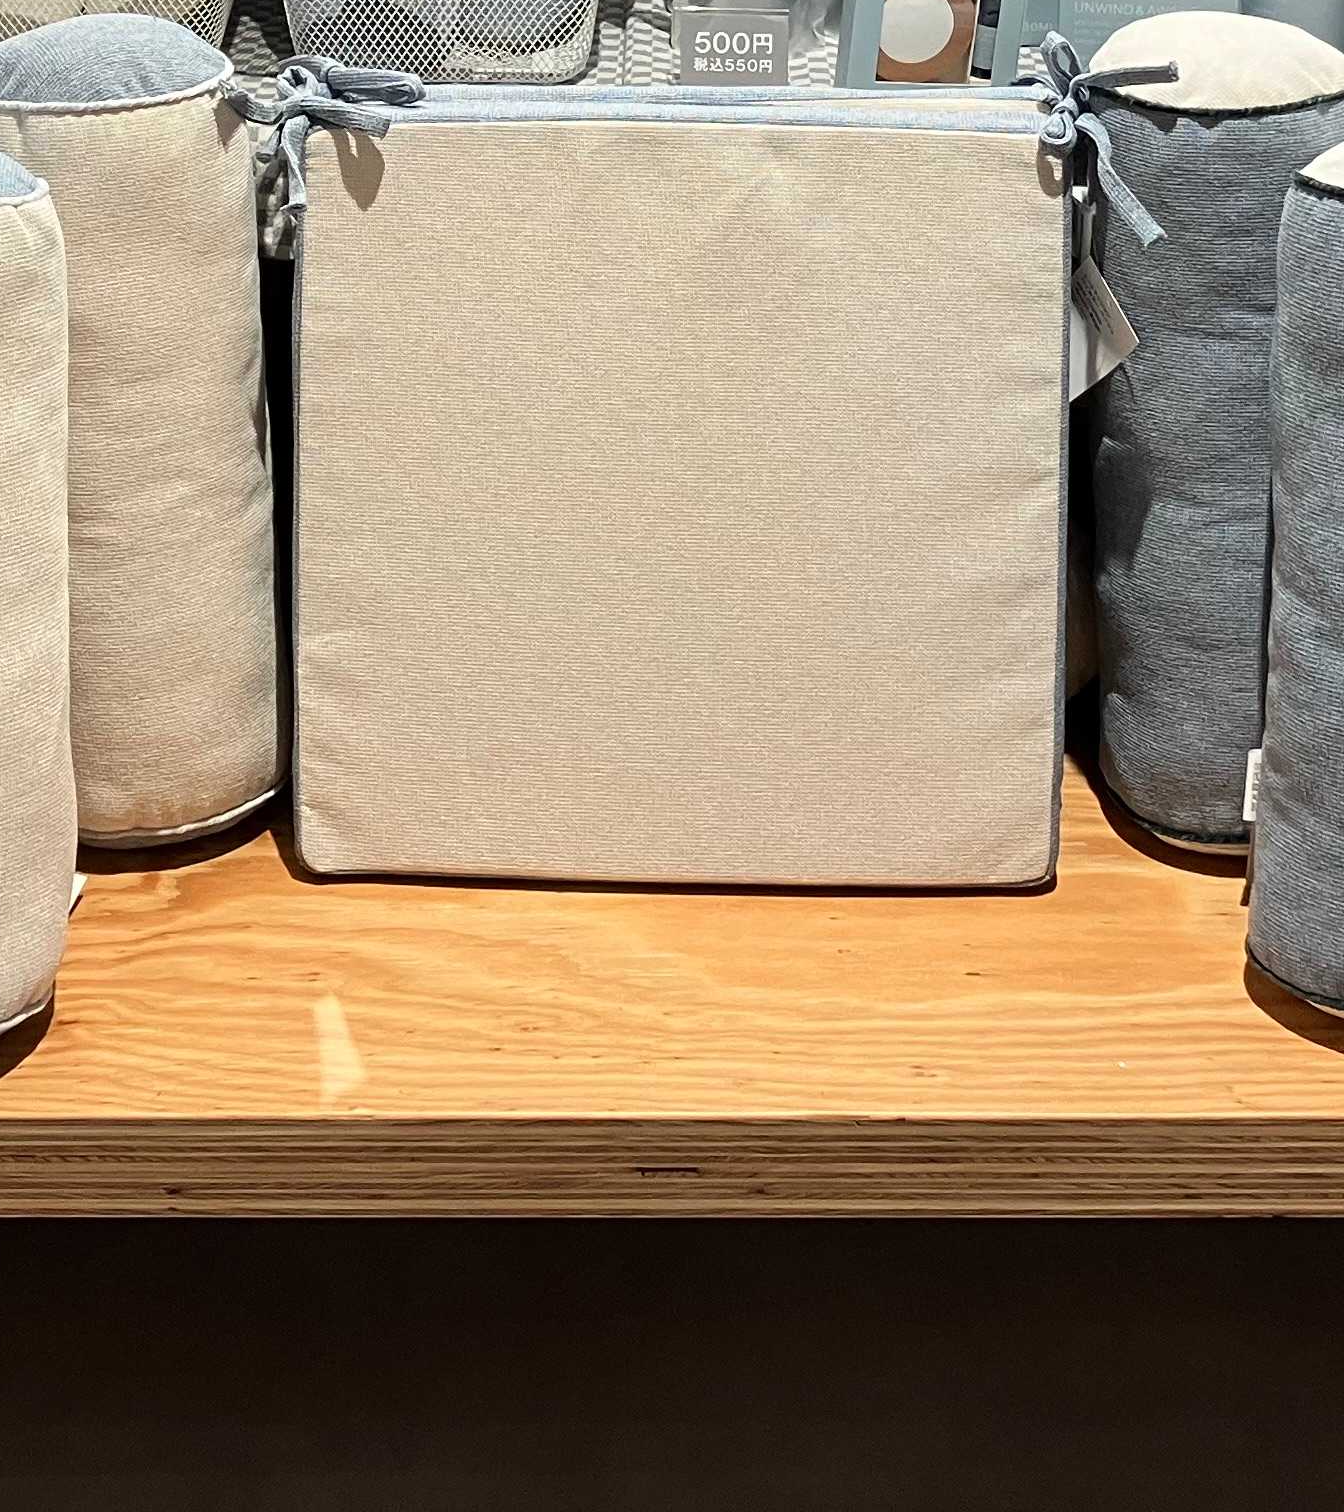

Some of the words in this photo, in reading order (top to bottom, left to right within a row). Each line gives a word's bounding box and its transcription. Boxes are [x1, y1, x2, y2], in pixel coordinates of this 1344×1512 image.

[694, 31, 773, 55] 500円
[693, 57, 773, 73] 税込550円
